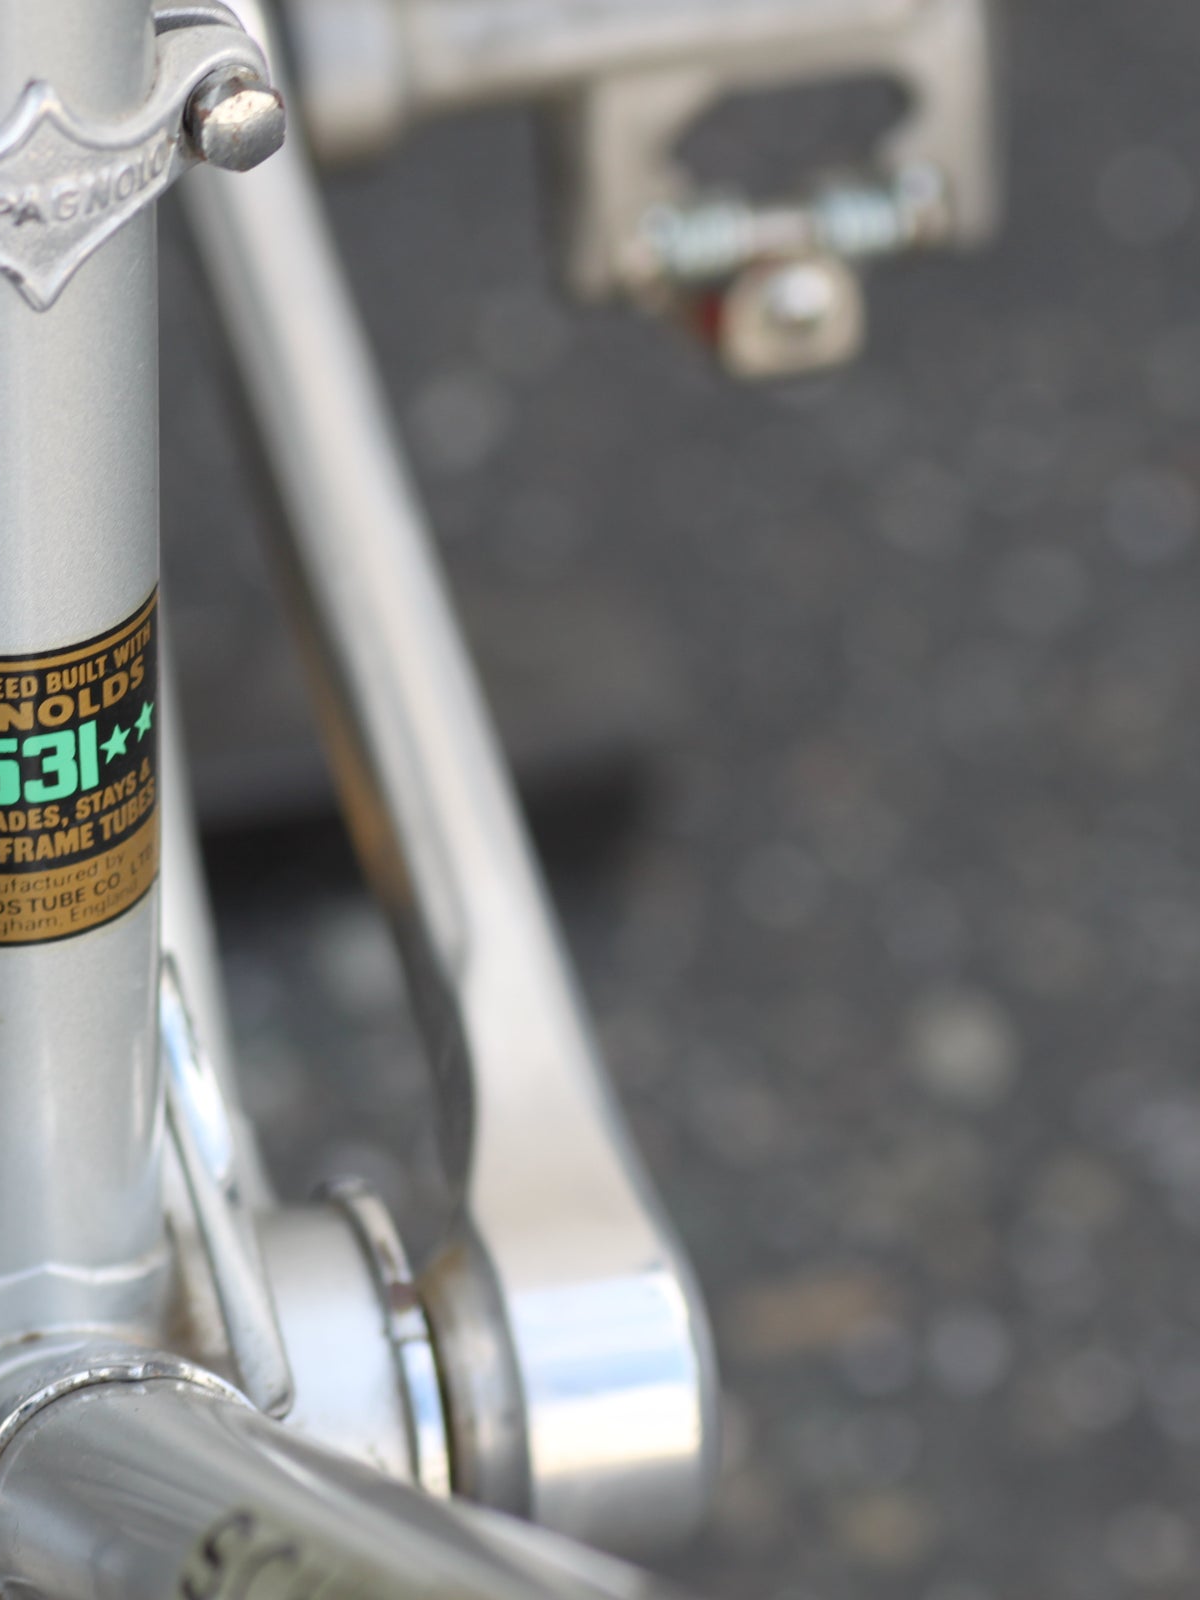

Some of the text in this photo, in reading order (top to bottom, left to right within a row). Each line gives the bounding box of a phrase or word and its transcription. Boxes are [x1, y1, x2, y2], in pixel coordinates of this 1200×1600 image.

[45, 654, 108, 694] BUILT
[113, 620, 151, 669] WITH
[75, 769, 137, 821] STAYS
[28, 886, 87, 914] TUBE
